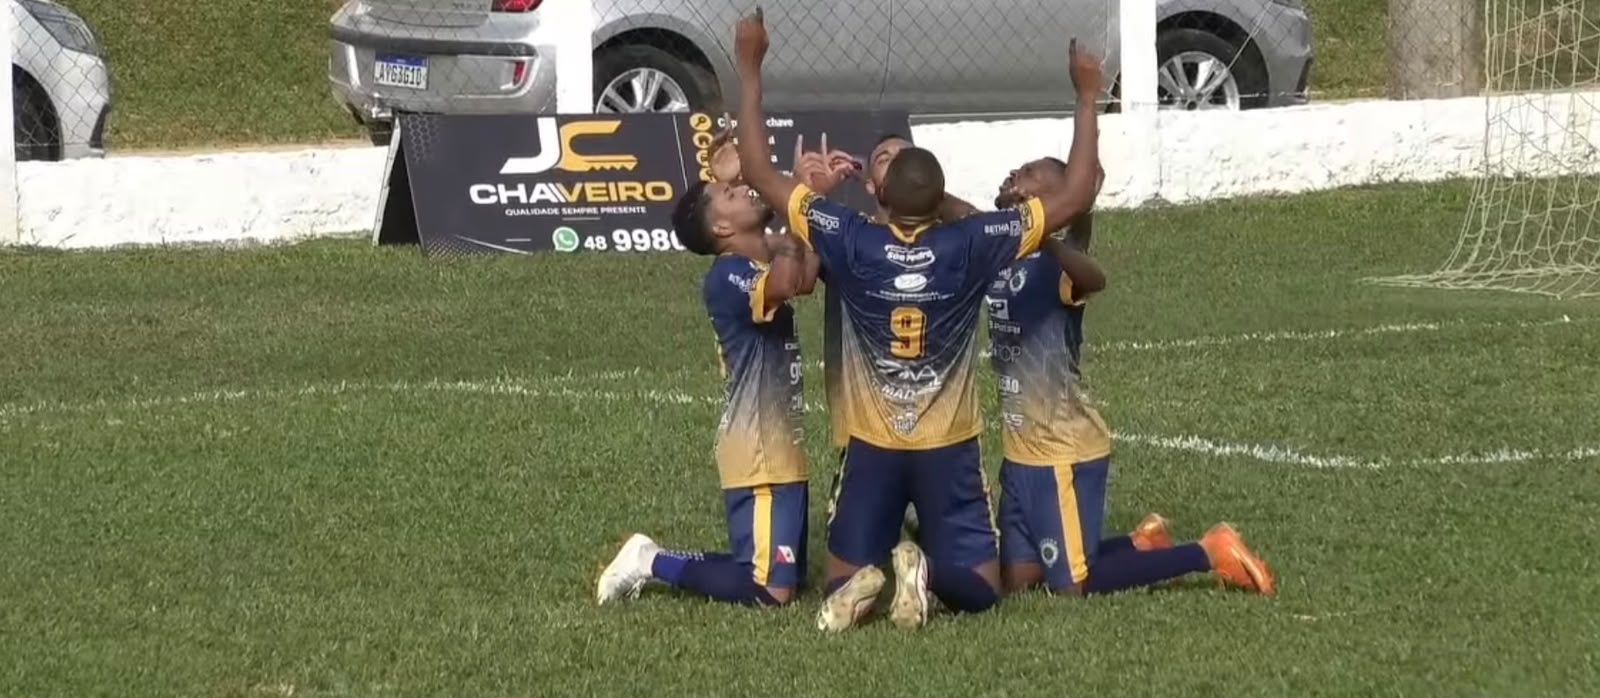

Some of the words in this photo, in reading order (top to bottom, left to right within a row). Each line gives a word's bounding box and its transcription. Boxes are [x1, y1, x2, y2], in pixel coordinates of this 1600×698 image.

[766, 116, 794, 127] chave
[505, 207, 560, 217] QUALIDADE
[561, 206, 599, 215] SEMPRE
[600, 205, 647, 214] PRESENTE
[584, 235, 607, 250] 48
[890, 306, 927, 358] 9
